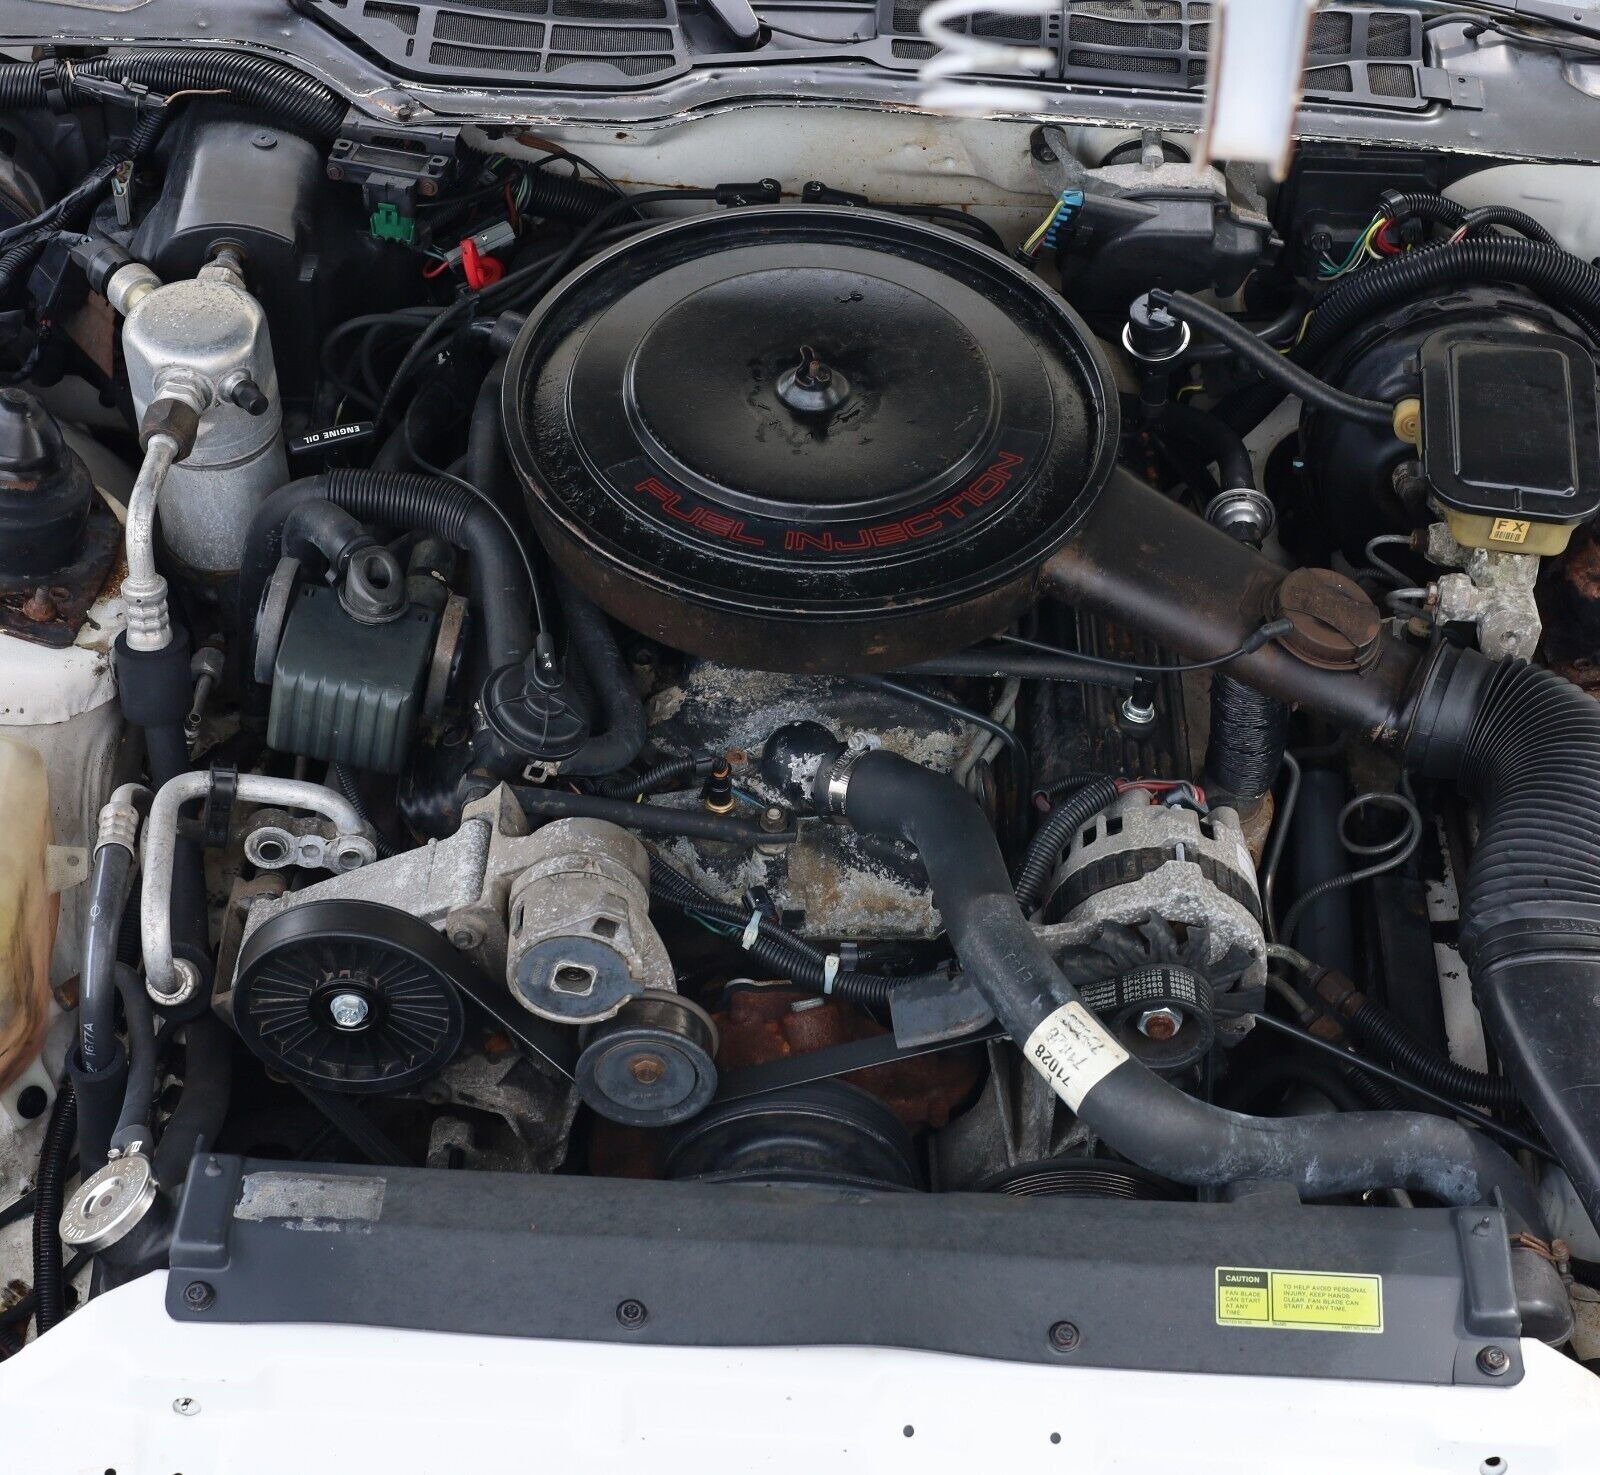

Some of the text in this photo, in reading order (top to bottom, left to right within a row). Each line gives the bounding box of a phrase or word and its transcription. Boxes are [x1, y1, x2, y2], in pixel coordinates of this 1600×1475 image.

[303, 425, 360, 444] ENGINE OIL
[634, 452, 1024, 552] FUEL INJECTION
[84, 1022, 95, 1056] 1677A
[1035, 1044, 1071, 1087] 71028
[1225, 1275, 1260, 1283] CAUTION
